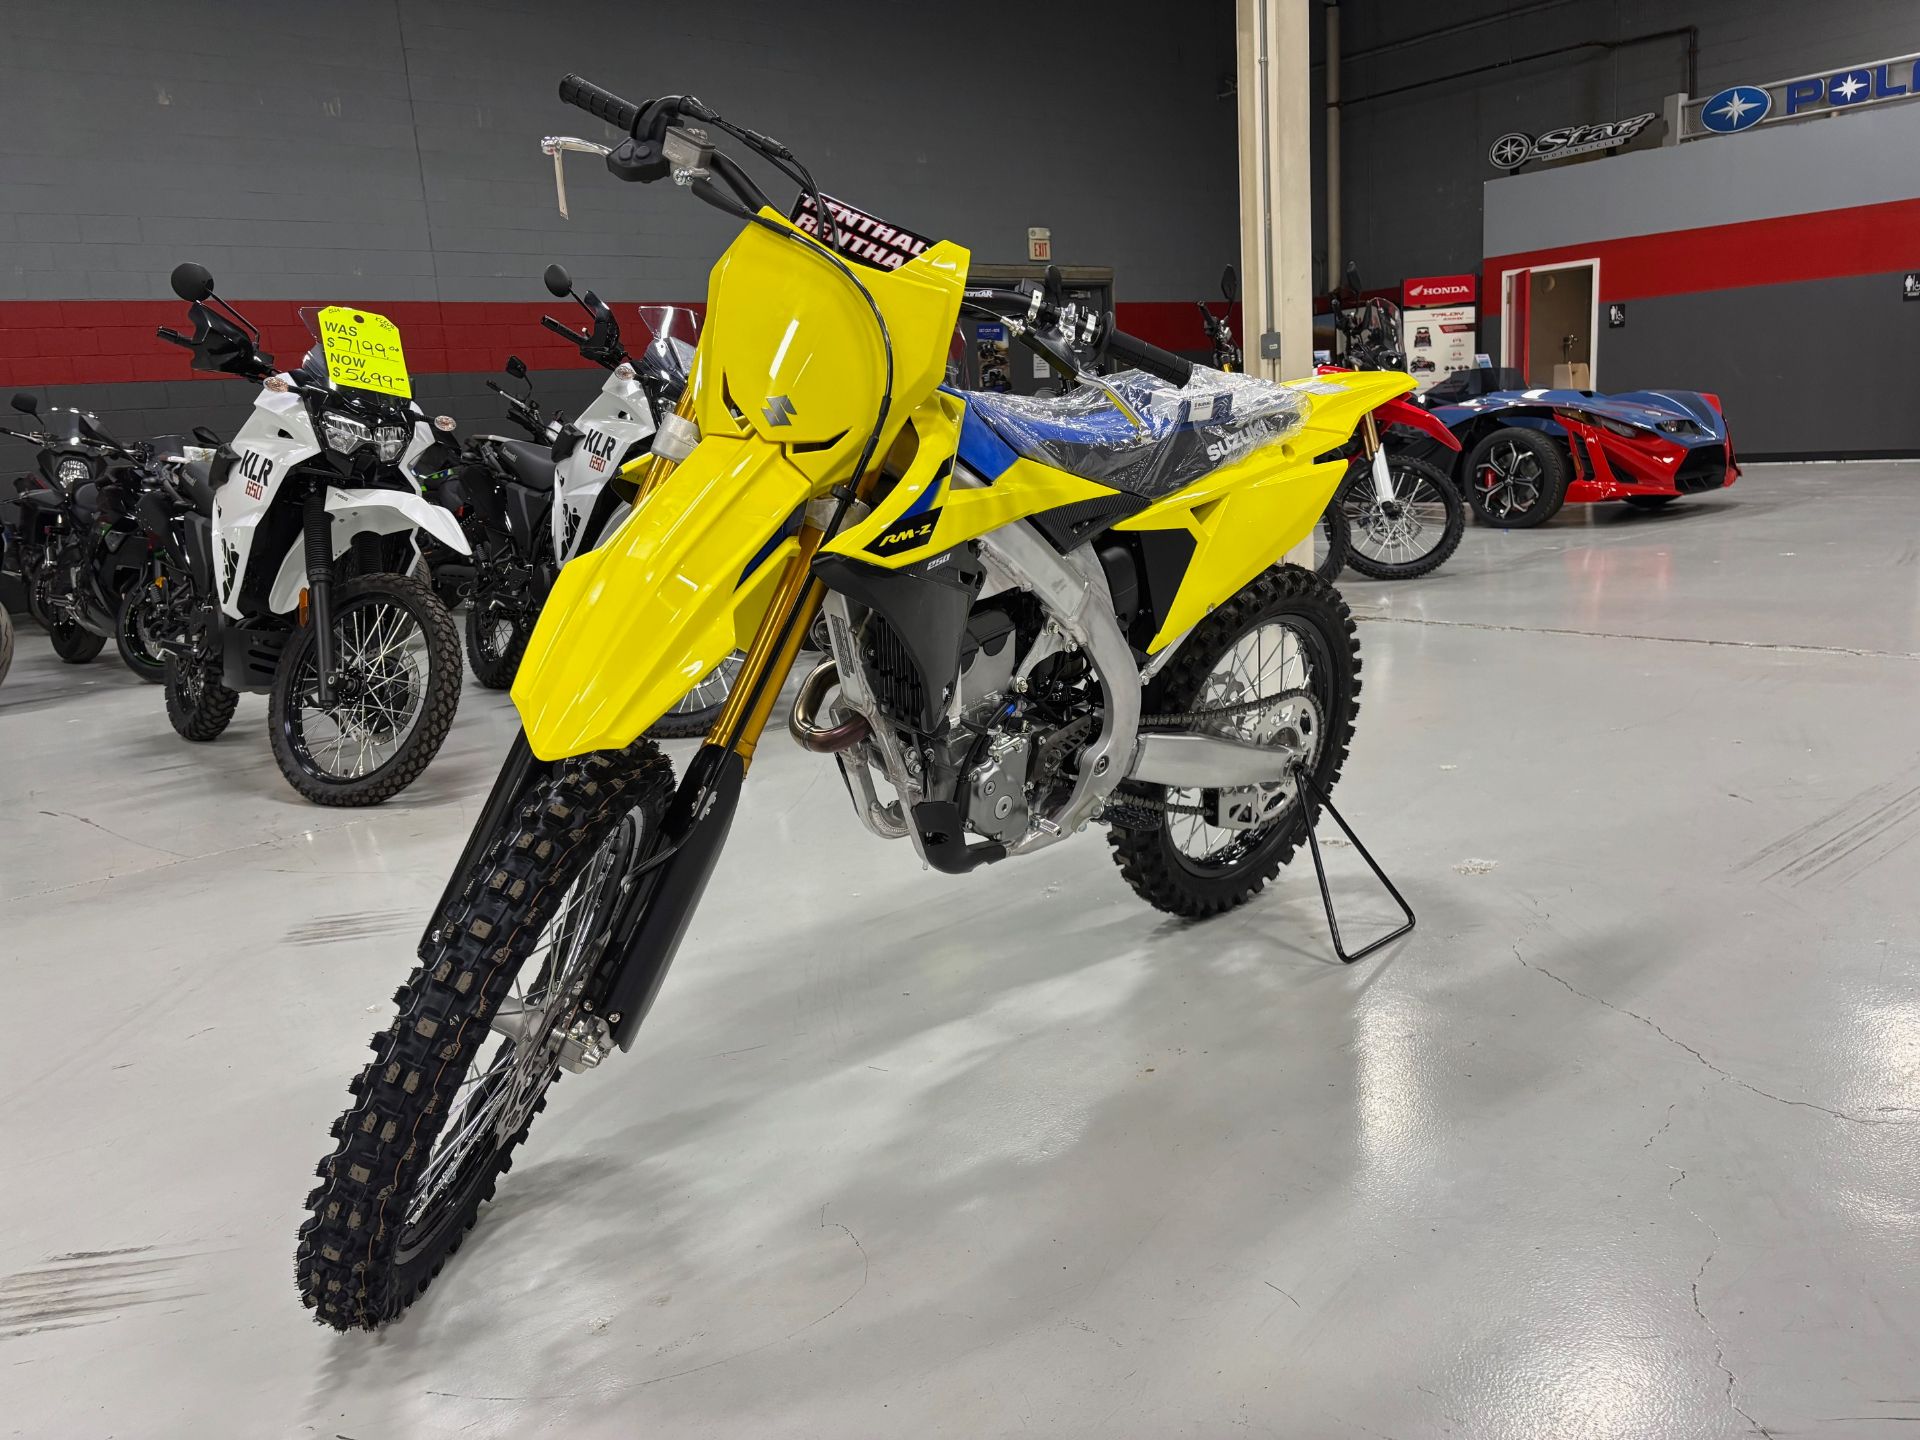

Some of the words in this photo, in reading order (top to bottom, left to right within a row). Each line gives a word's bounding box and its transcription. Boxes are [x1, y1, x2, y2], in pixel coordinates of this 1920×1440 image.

[1786, 58, 1920, 115] POL
[1534, 113, 1655, 154] Star
[1034, 242, 1048, 258] EXIT
[1423, 285, 1470, 296] HONDA
[325, 321, 358, 337] WAS
[330, 352, 366, 368] NOW
[583, 428, 616, 461] KLR
[1206, 418, 1269, 462] SUZUKI
[239, 449, 274, 487] KLR
[589, 455, 606, 473] 650
[245, 480, 263, 501] 650
[878, 523, 932, 547] RM-Z
[926, 552, 951, 571] 250
